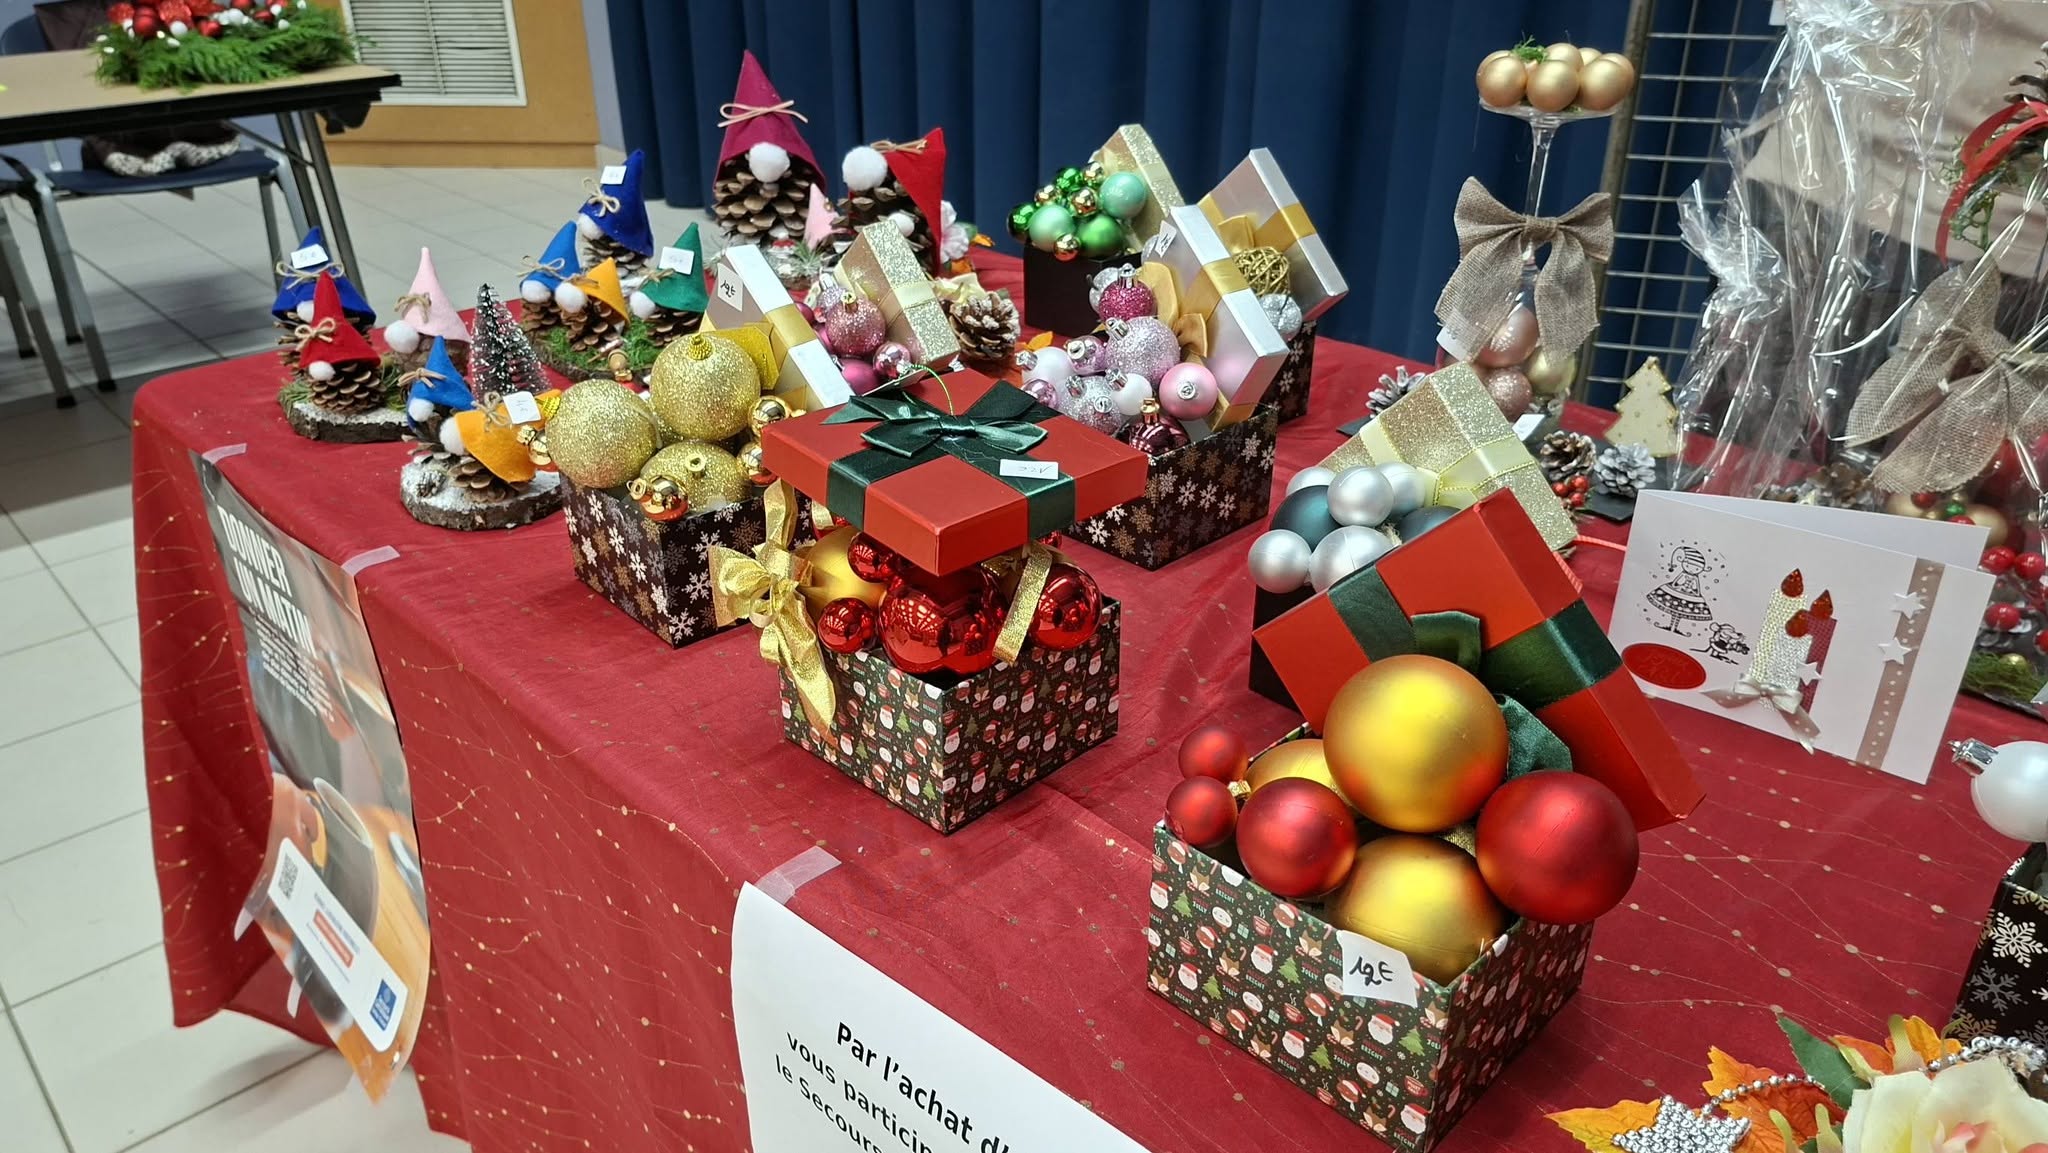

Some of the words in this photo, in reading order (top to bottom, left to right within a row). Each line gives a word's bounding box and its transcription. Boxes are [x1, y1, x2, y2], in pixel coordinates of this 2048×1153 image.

[216, 504, 293, 598] DONNER
[257, 576, 318, 660] MATIN
[1348, 955, 1394, 987] 12€
[775, 1053, 793, 1084] le
[786, 1031, 836, 1084] vous
[837, 1021, 877, 1068] Par
